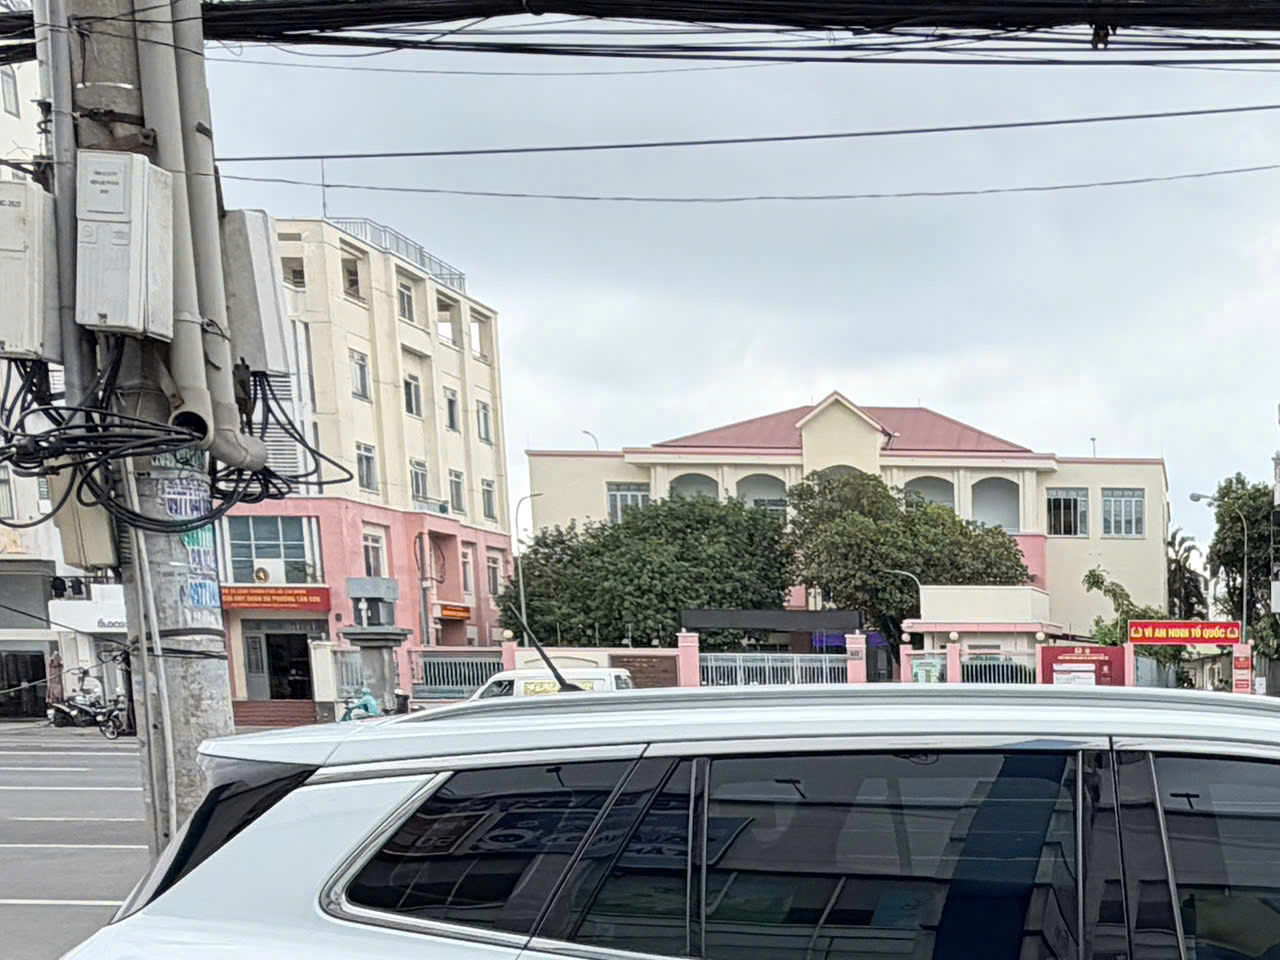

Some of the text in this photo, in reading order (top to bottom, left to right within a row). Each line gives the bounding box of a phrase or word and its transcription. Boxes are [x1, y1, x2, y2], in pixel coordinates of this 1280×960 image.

[1154, 628, 1166, 638] AN
[1168, 628, 1189, 638] NINH
[1203, 626, 1225, 639] QUỐC
